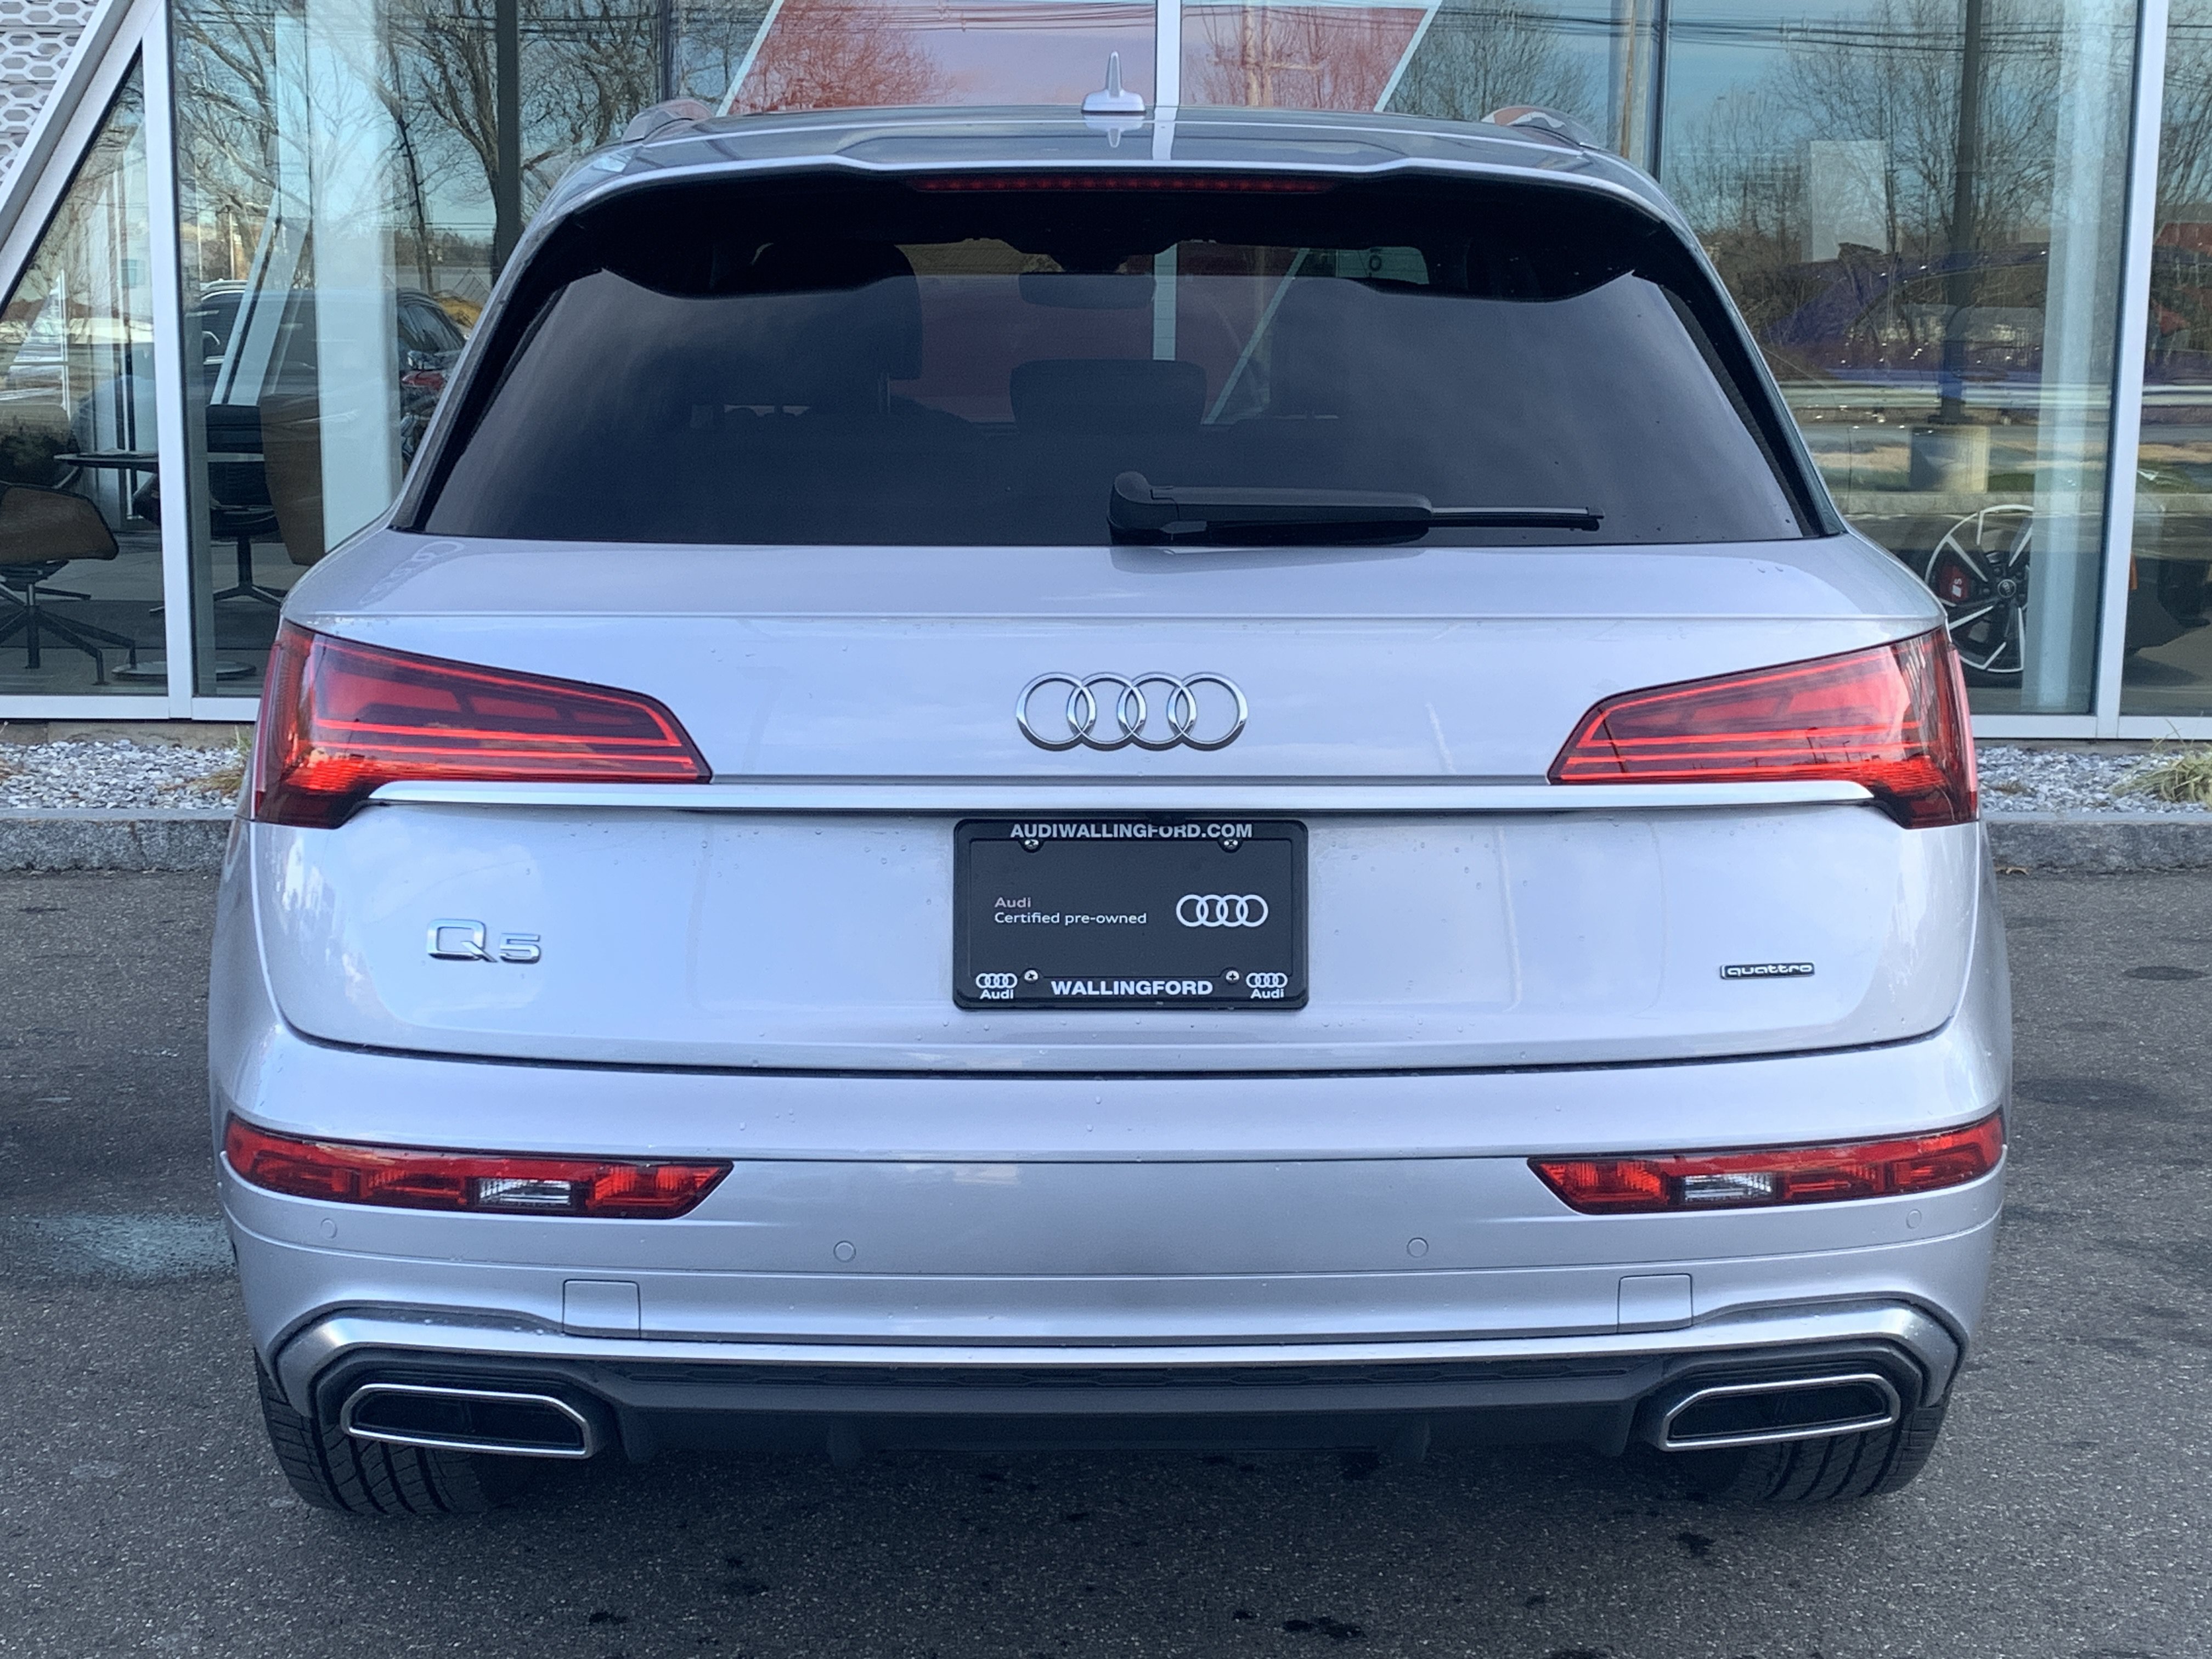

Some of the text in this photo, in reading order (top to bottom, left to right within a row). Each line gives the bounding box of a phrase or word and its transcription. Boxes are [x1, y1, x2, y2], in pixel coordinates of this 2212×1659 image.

[1011, 824, 1252, 838] AUDIWALLINGFORD.COM
[995, 897, 1031, 908] Audi
[995, 912, 1147, 925] Certified pre-owned
[426, 918, 540, 964] Q5
[1727, 964, 1813, 977] quattro
[980, 989, 1014, 999] Audi
[1051, 981, 1213, 995] WALLINGFORD
[1251, 989, 1284, 998] Audi
